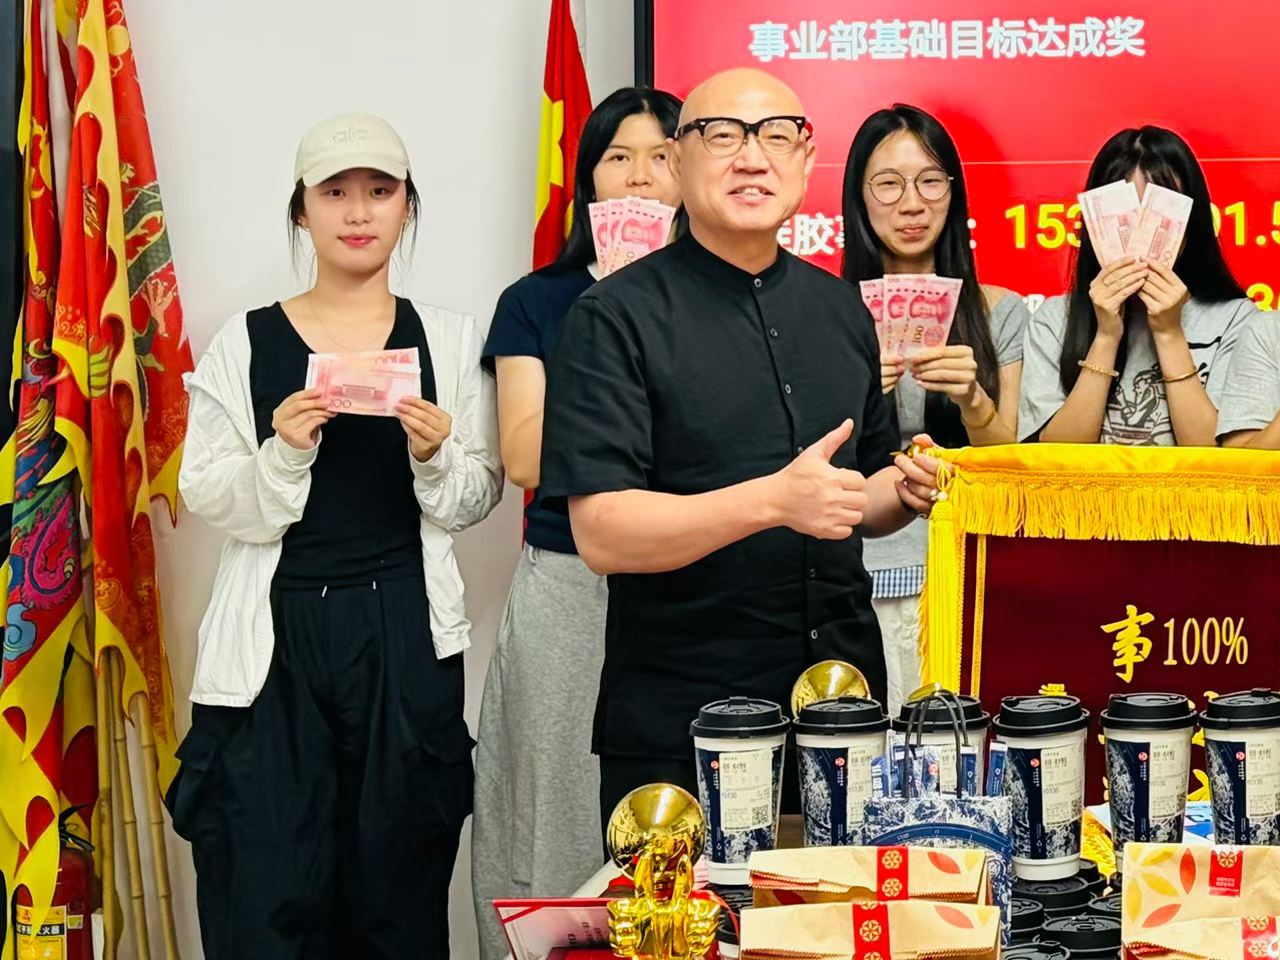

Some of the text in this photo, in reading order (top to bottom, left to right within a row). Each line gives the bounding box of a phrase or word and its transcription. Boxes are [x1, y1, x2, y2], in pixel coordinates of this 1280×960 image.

[748, 16, 1146, 61] 事业部基础目标达成奖
